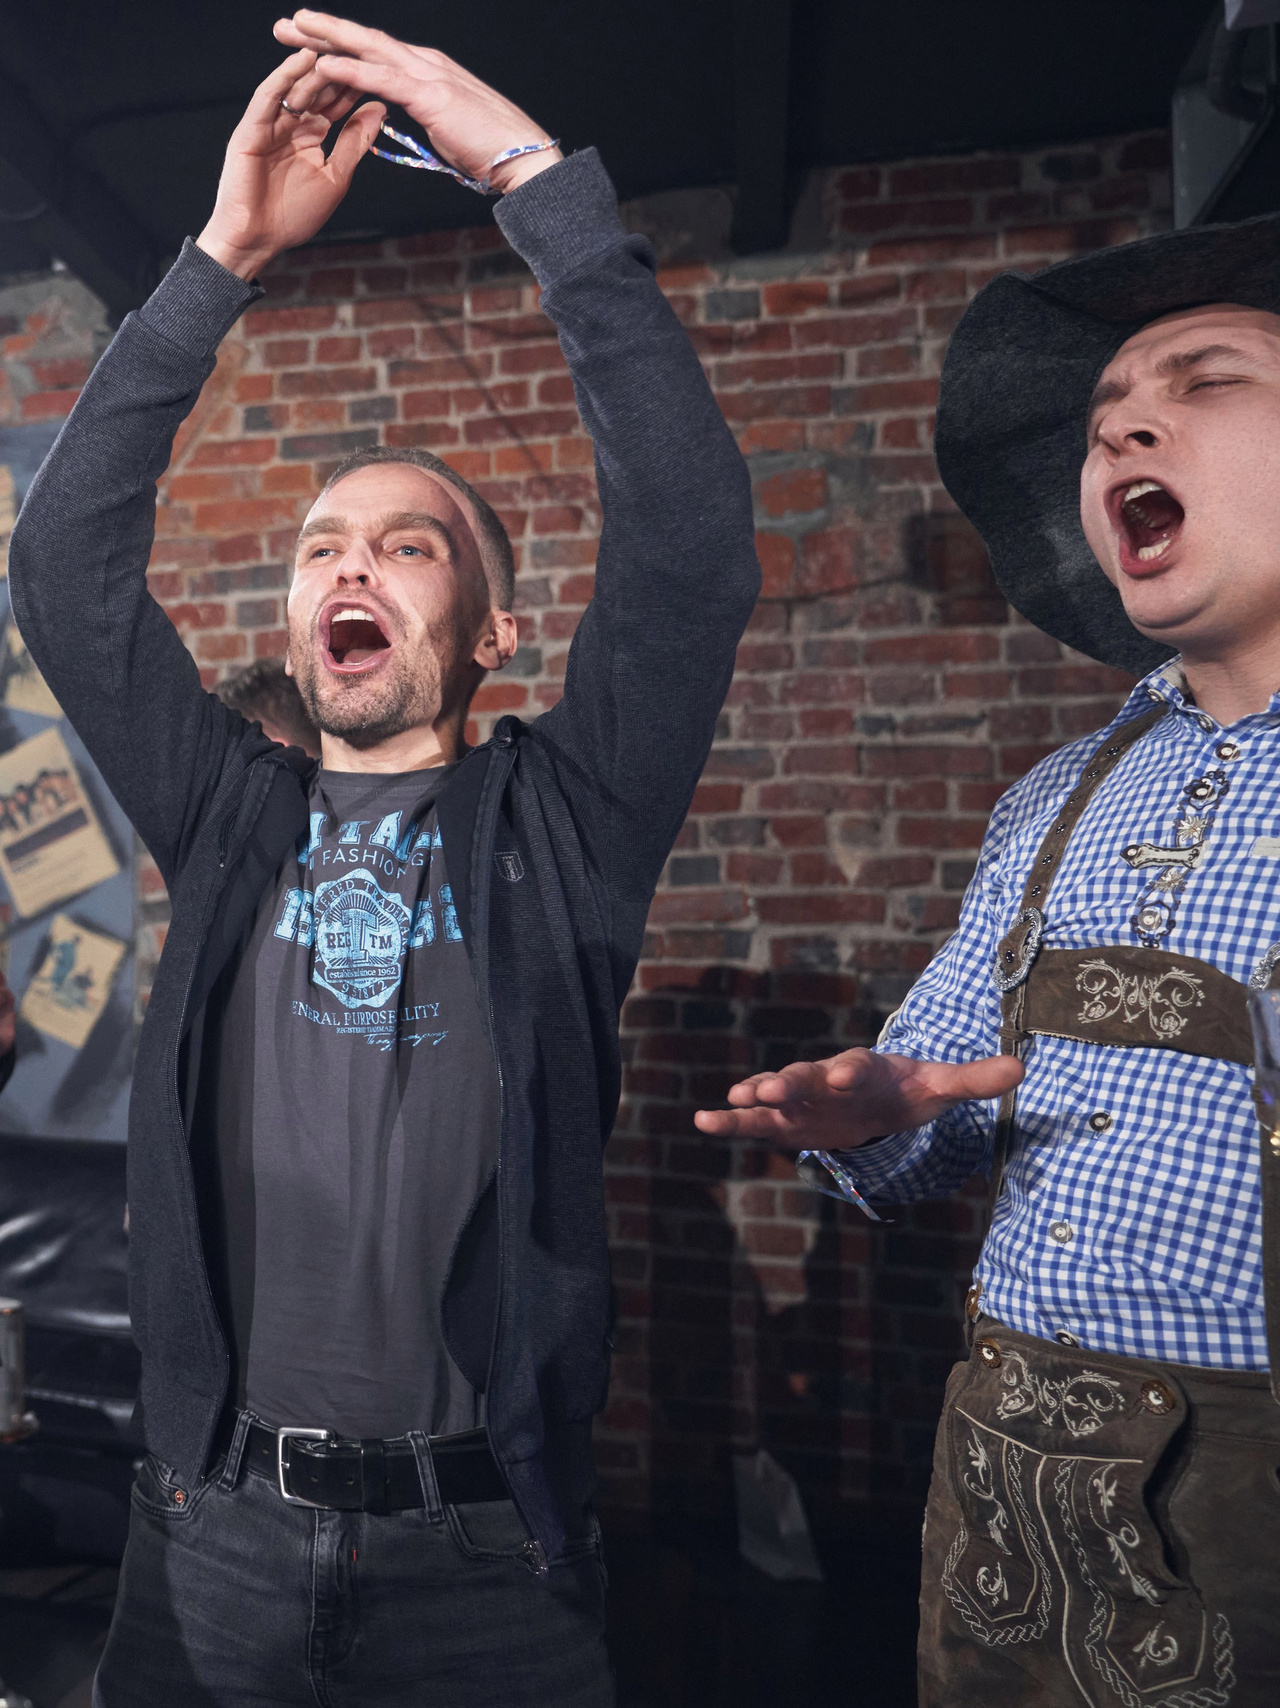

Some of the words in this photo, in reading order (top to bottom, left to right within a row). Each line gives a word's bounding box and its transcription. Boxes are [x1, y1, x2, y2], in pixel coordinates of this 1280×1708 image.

[322, 848, 407, 878] FASHION
[369, 933, 393, 949] TM
[378, 966, 397, 976] 1962
